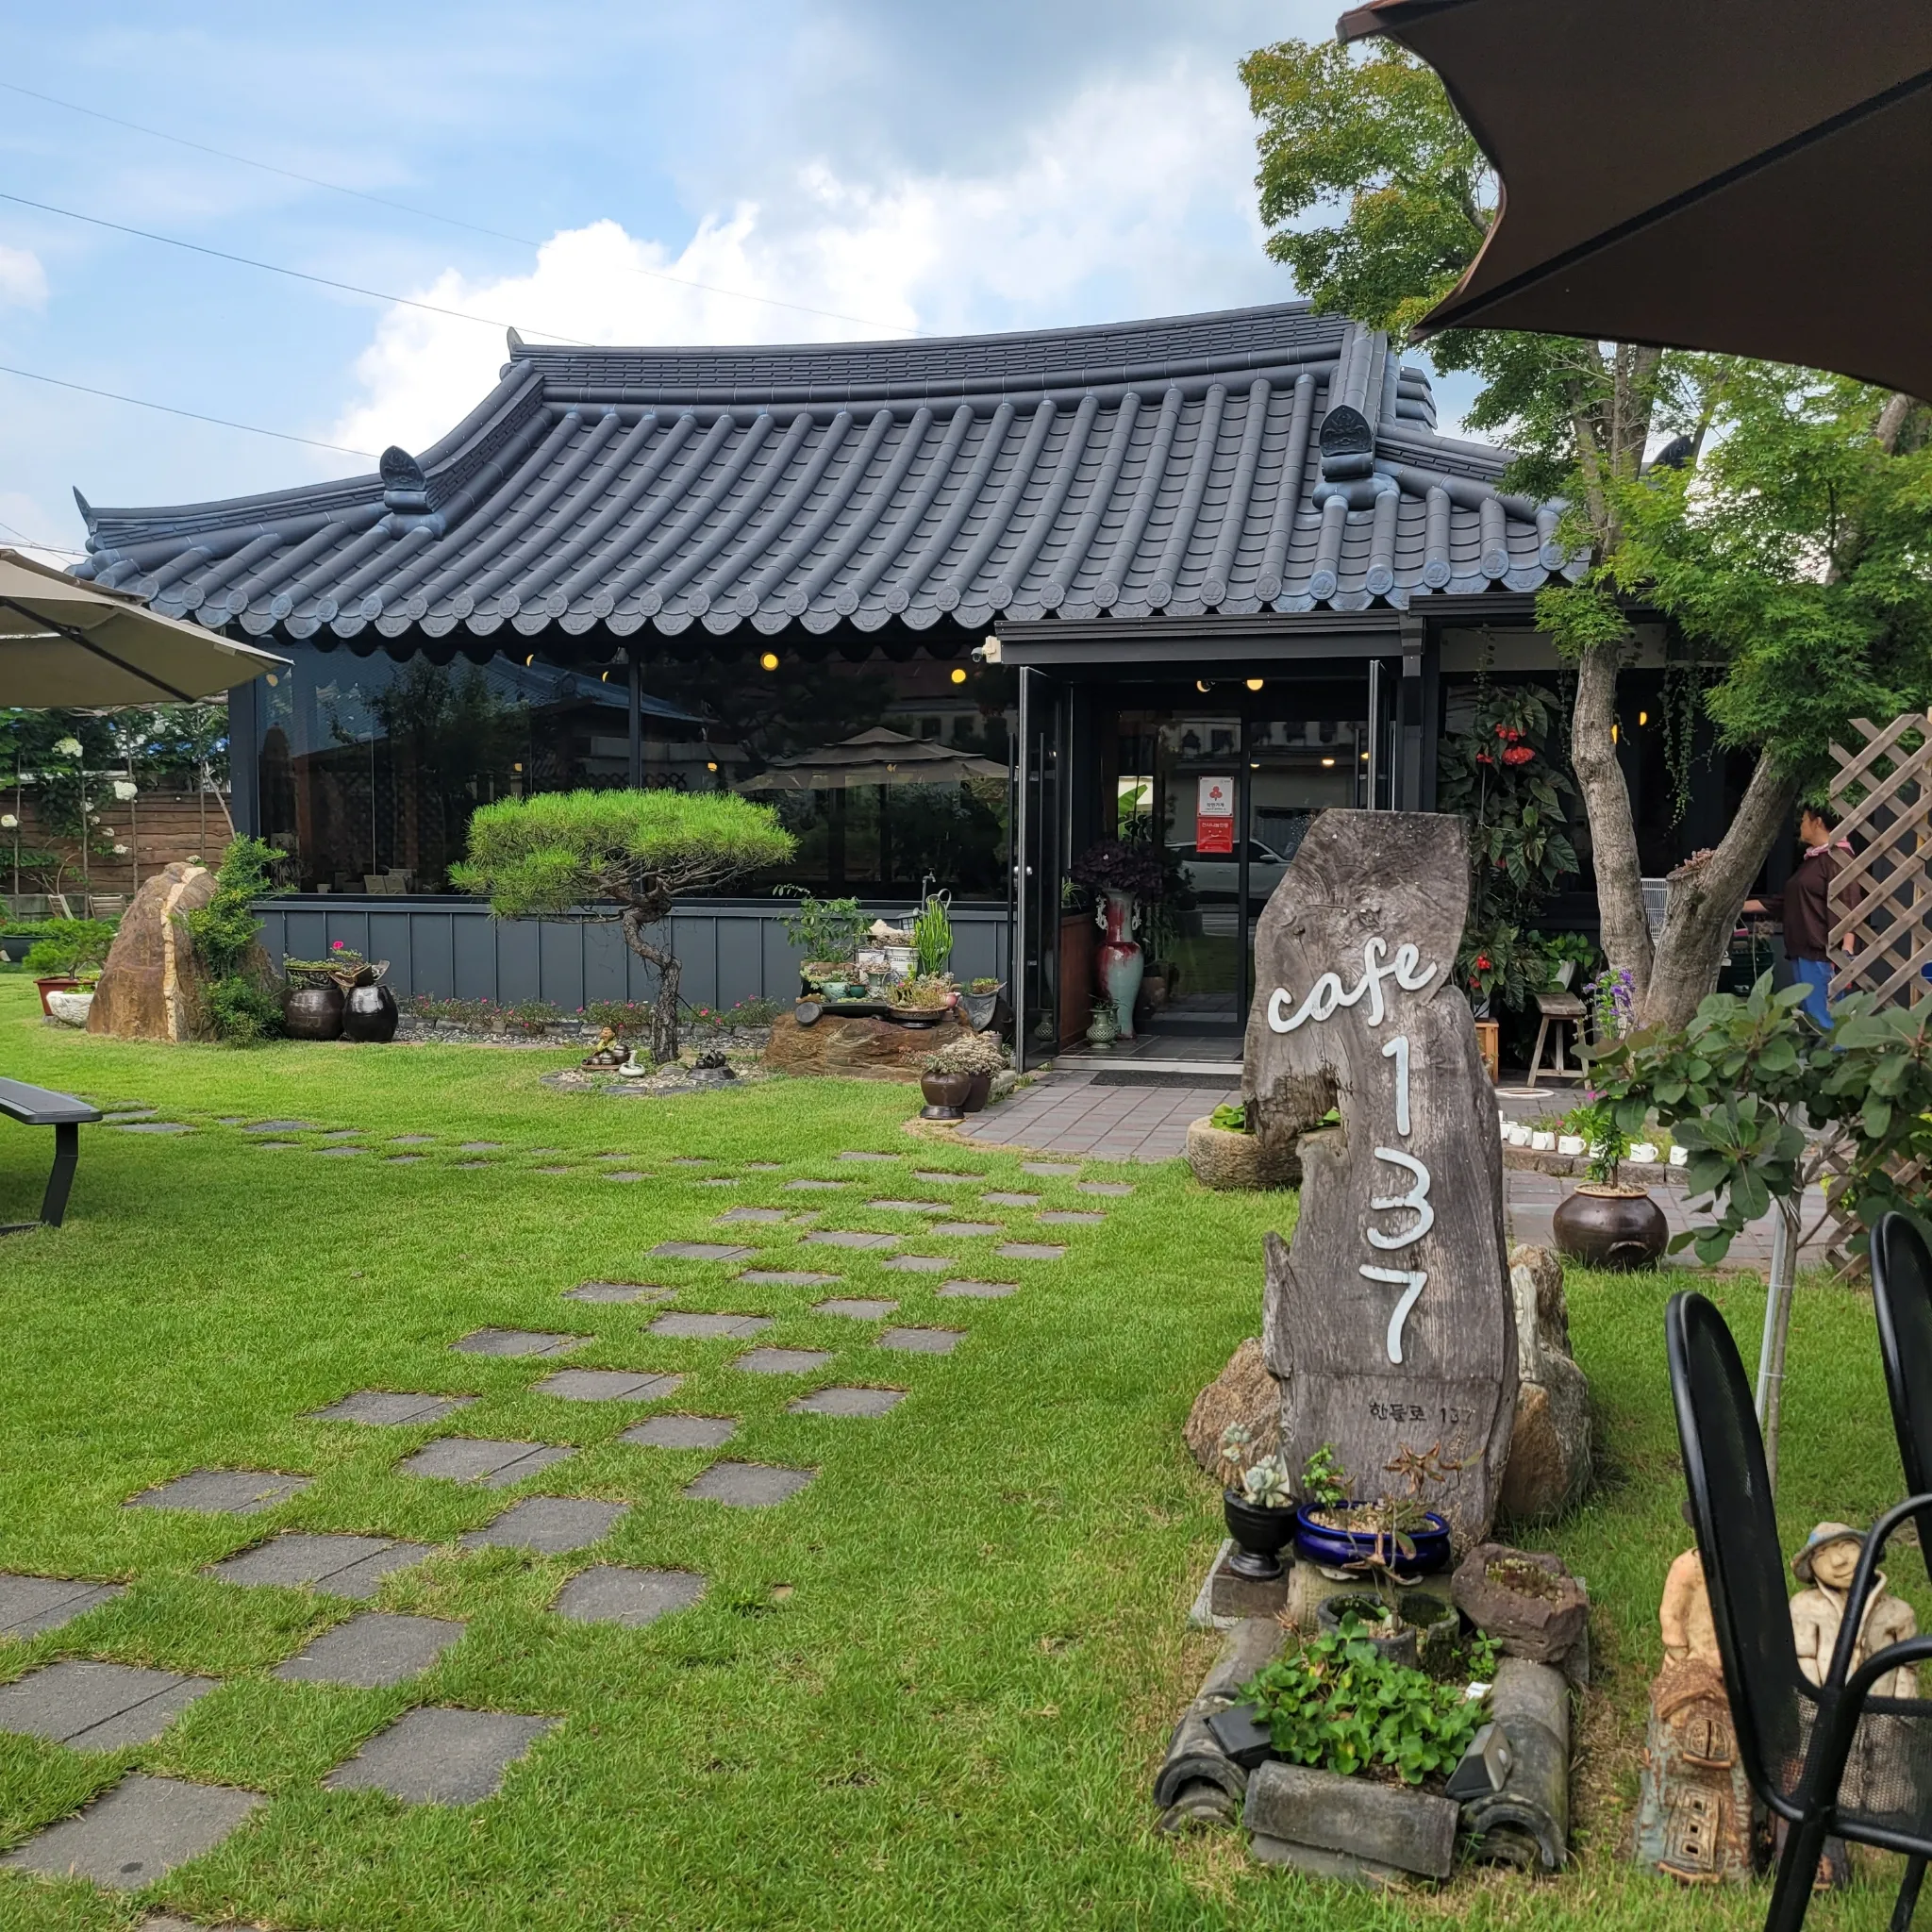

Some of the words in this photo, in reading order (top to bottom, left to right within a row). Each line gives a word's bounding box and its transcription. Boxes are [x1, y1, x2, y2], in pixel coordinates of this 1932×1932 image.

[1267, 936, 1439, 1034] cafe
[1358, 1034, 1435, 1365] 137
[1440, 1407, 1474, 1424] 137
